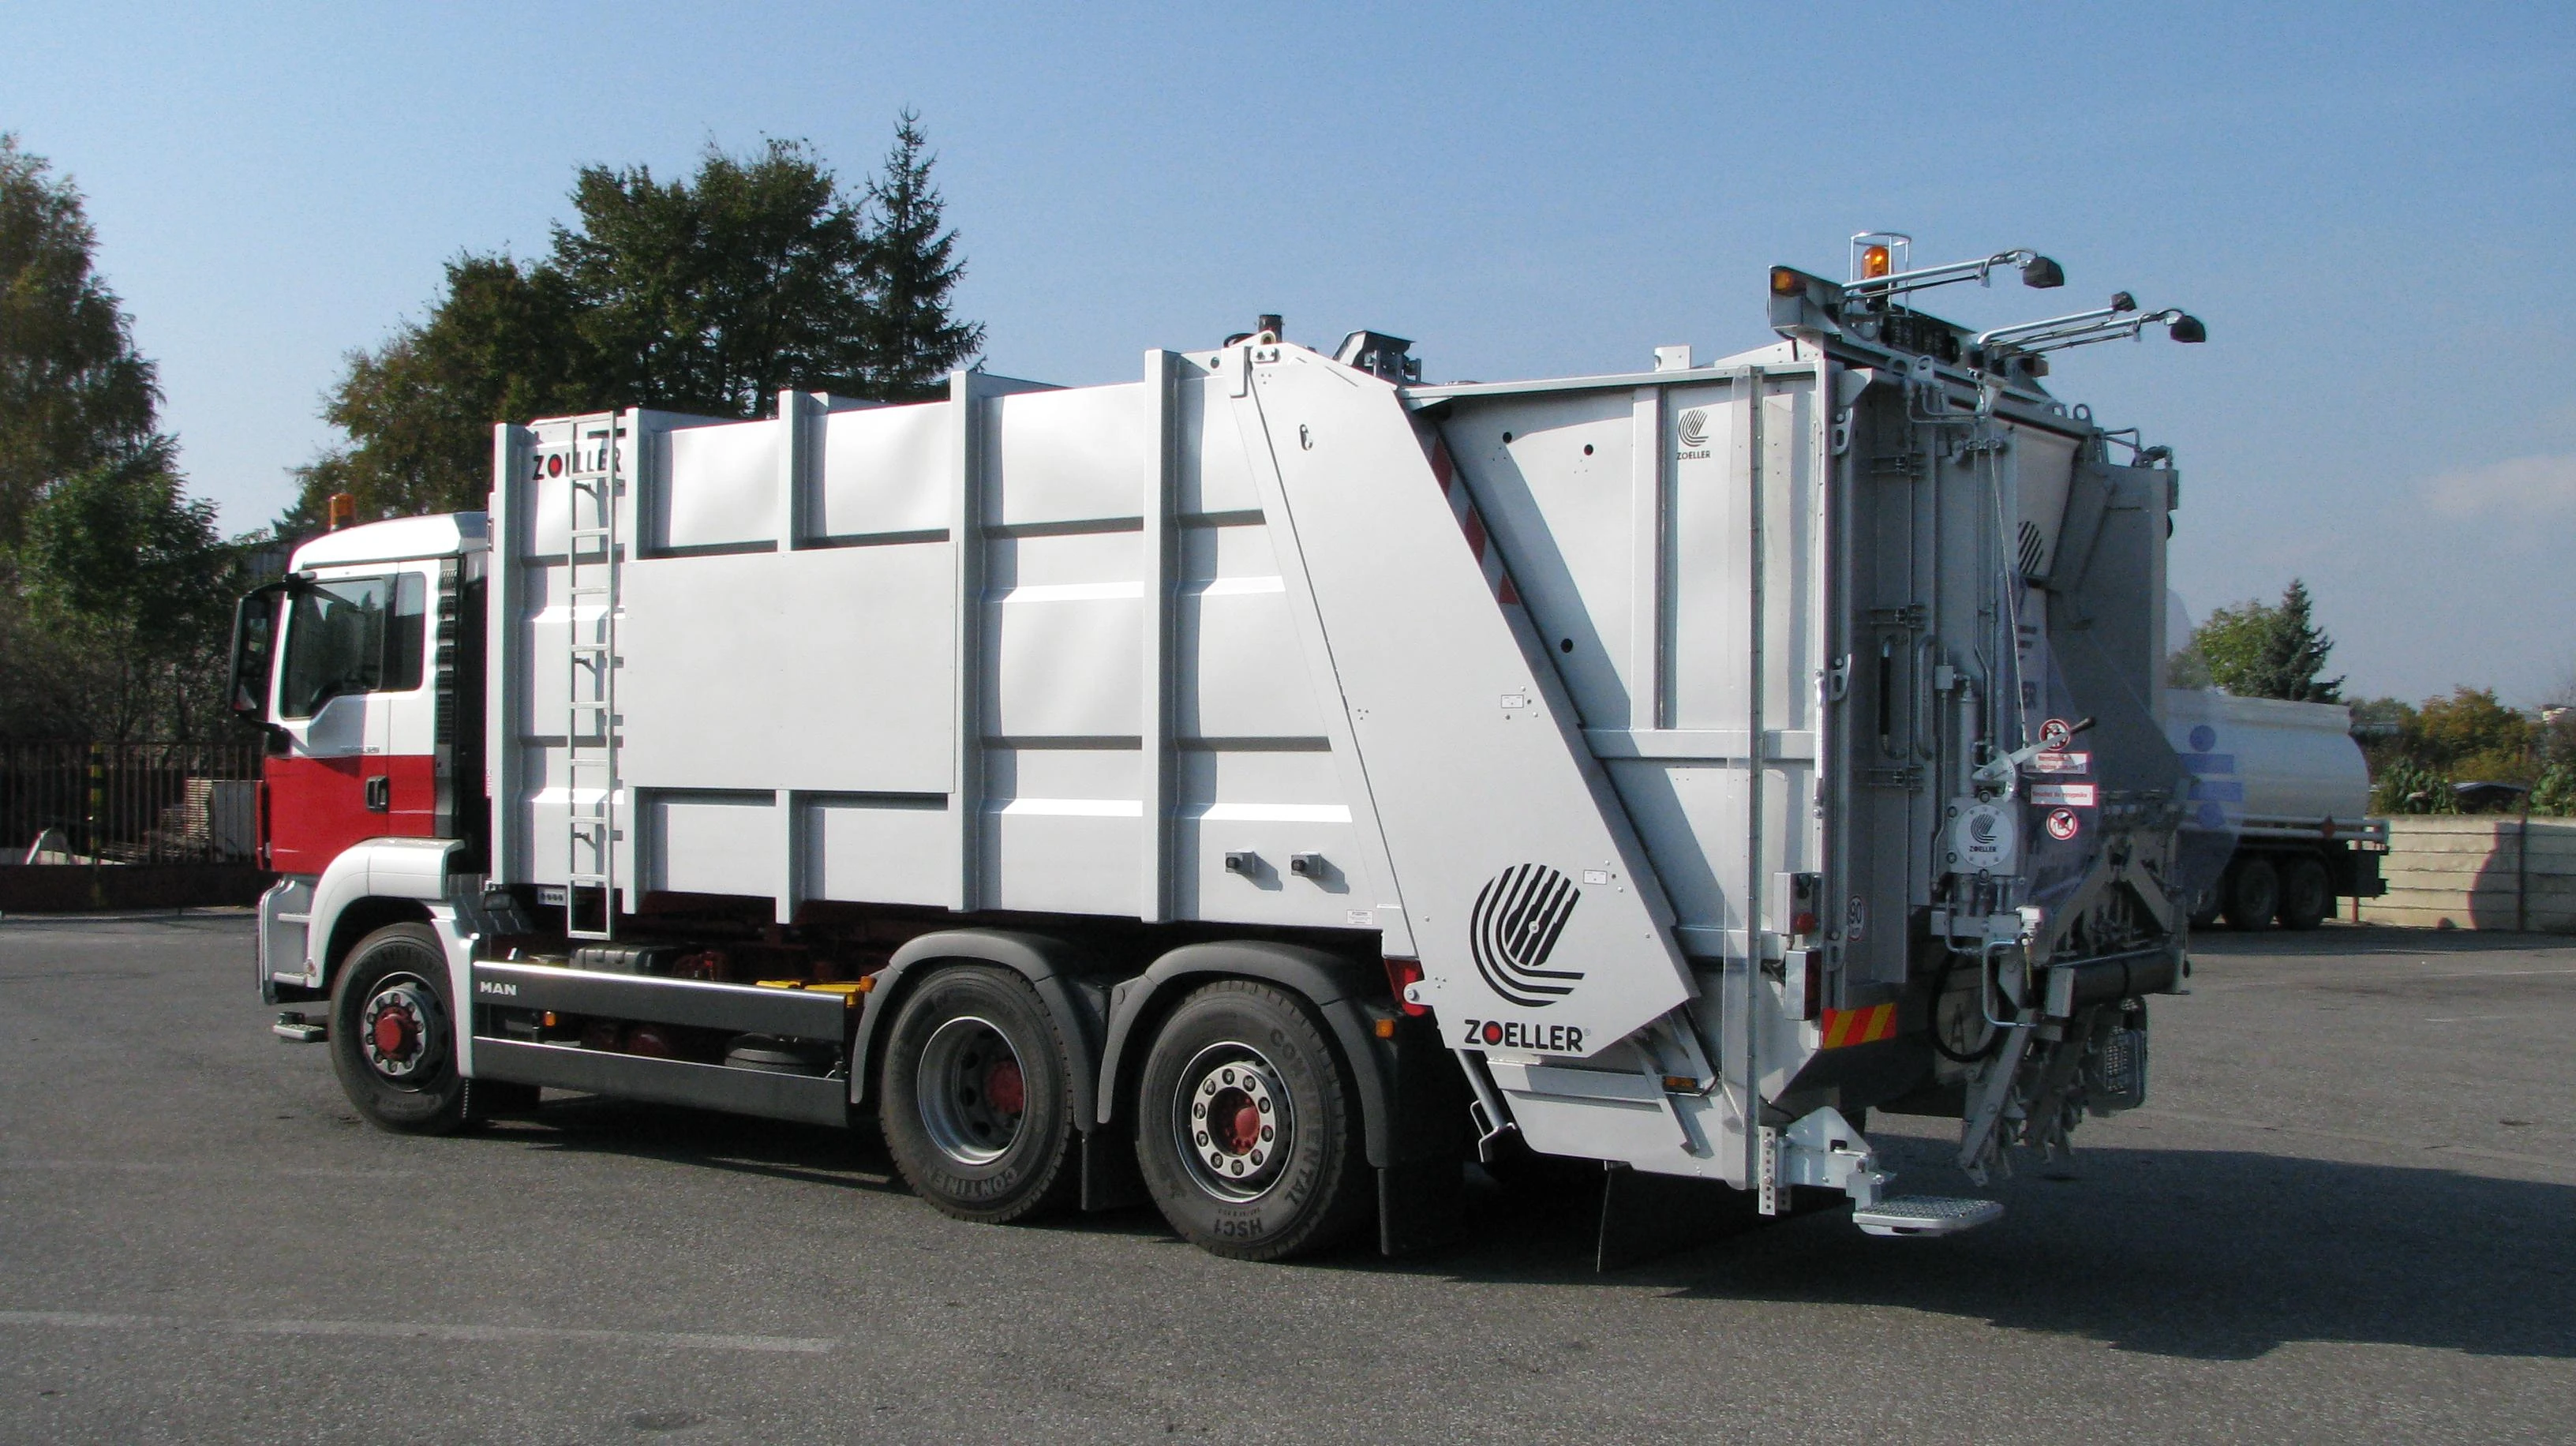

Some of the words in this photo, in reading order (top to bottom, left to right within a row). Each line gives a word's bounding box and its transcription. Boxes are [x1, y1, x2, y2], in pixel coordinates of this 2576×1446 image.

[1676, 450, 1711, 460] ZOELLER
[480, 981, 517, 995] MAN
[1464, 1018, 1583, 1052] ZOELLER
[1214, 1218, 1264, 1238] HSC1
